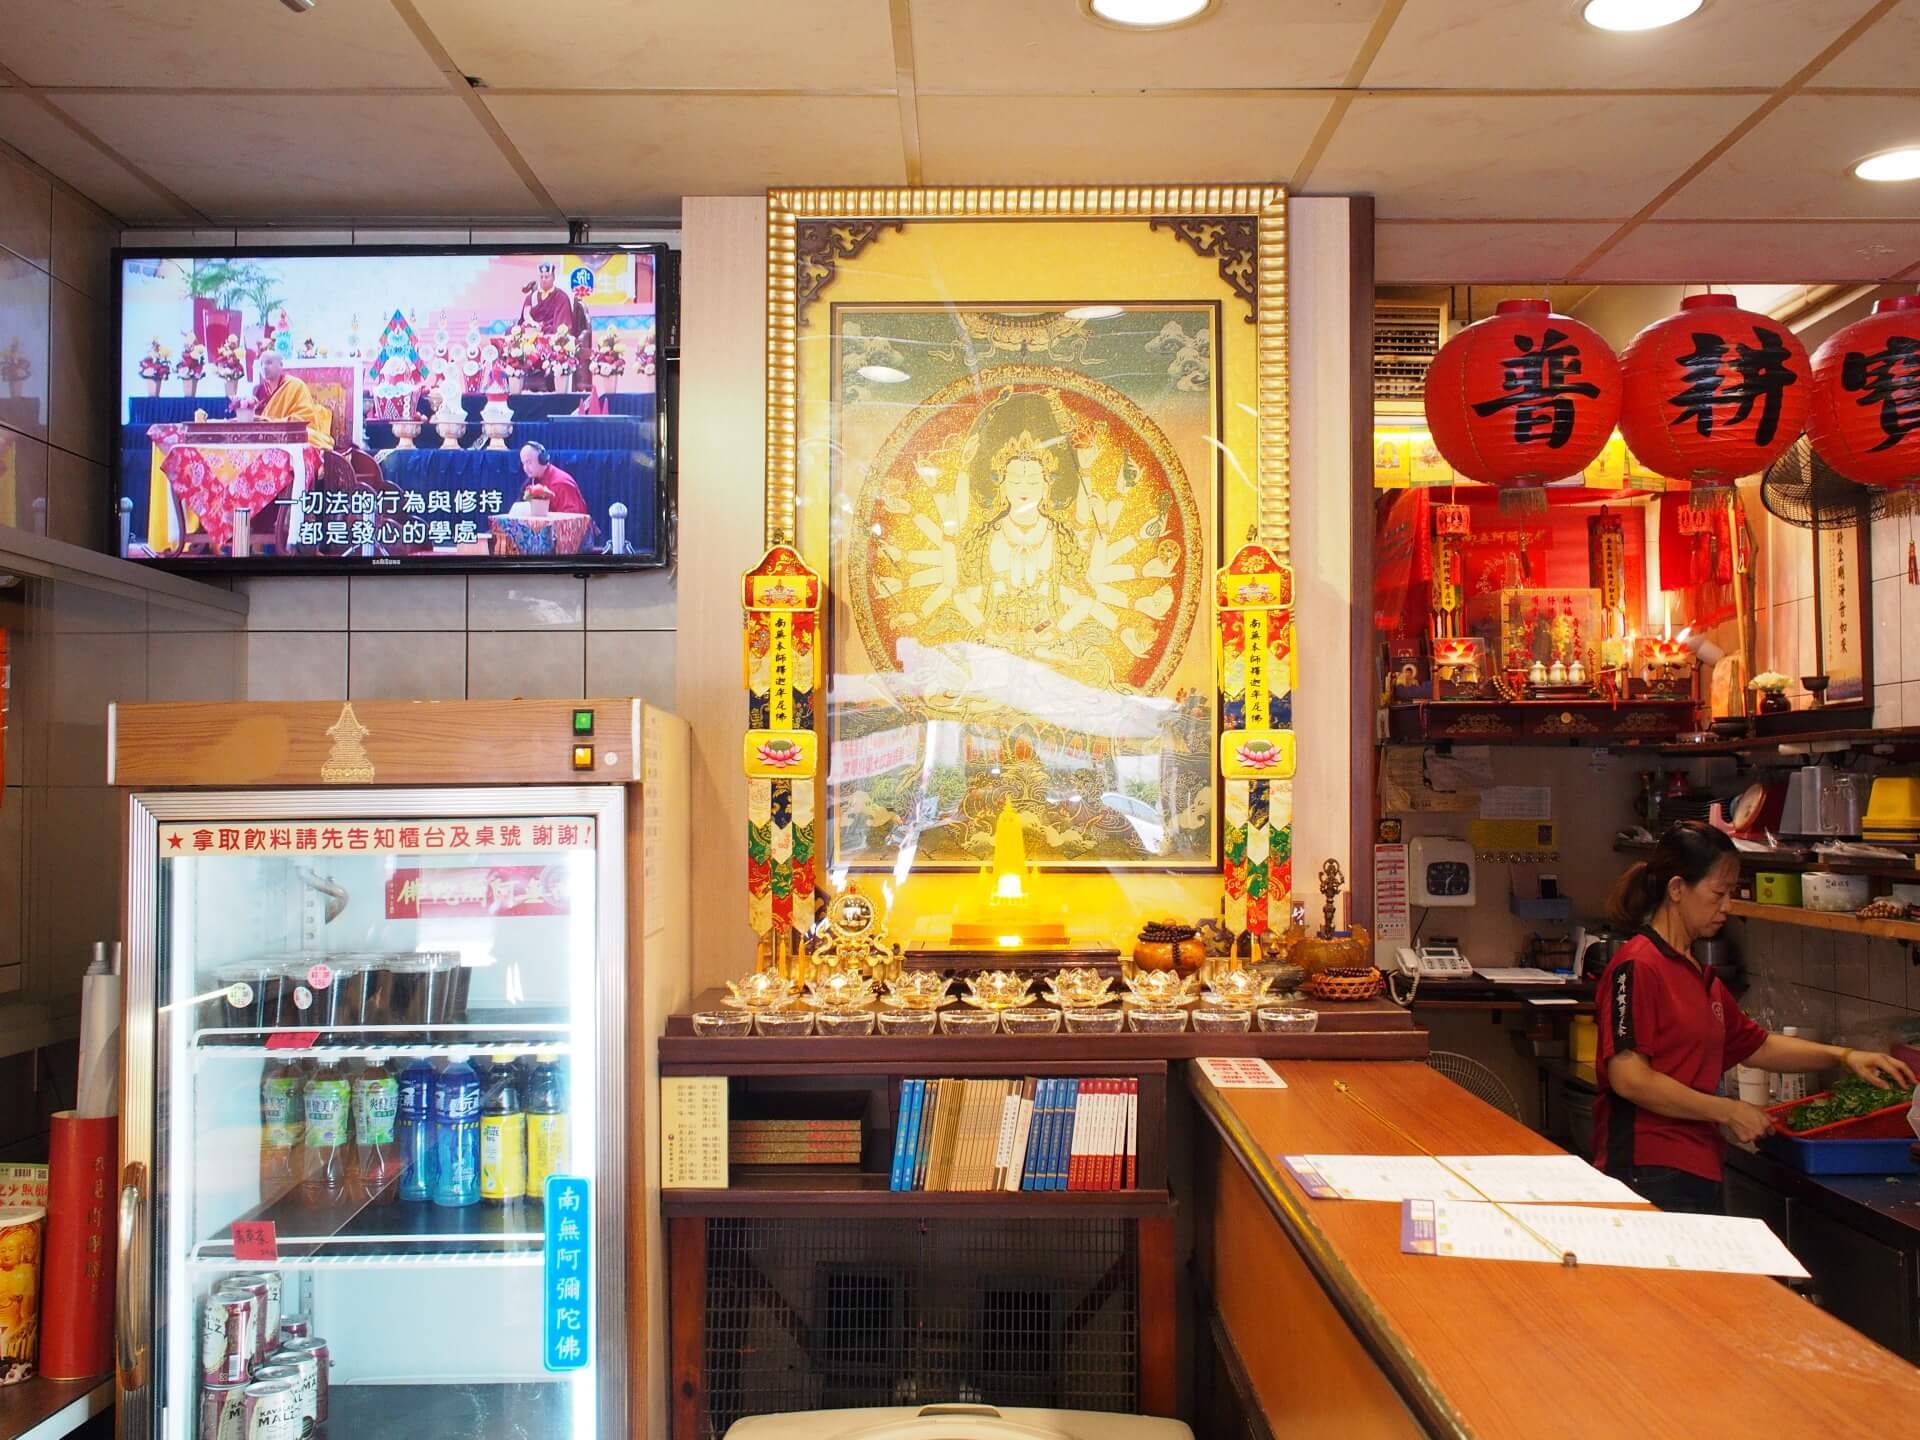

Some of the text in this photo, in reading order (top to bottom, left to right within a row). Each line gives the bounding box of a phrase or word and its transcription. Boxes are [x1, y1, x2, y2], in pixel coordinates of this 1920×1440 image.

[1472, 327, 1600, 449] 普
[1669, 326, 1797, 446] 耕
[274, 489, 503, 514] 一切法的行為與修持
[300, 520, 478, 545] 都是發心的學處
[774, 616, 787, 722] 南無本師釋迦牟尼佛
[1249, 617, 1264, 723] 南無本師釋迦牟尼佛
[192, 825, 521, 851] 拿取飲料請先告知櫃台及桌號
[555, 1185, 582, 1361] 南無阿彌陀佛
